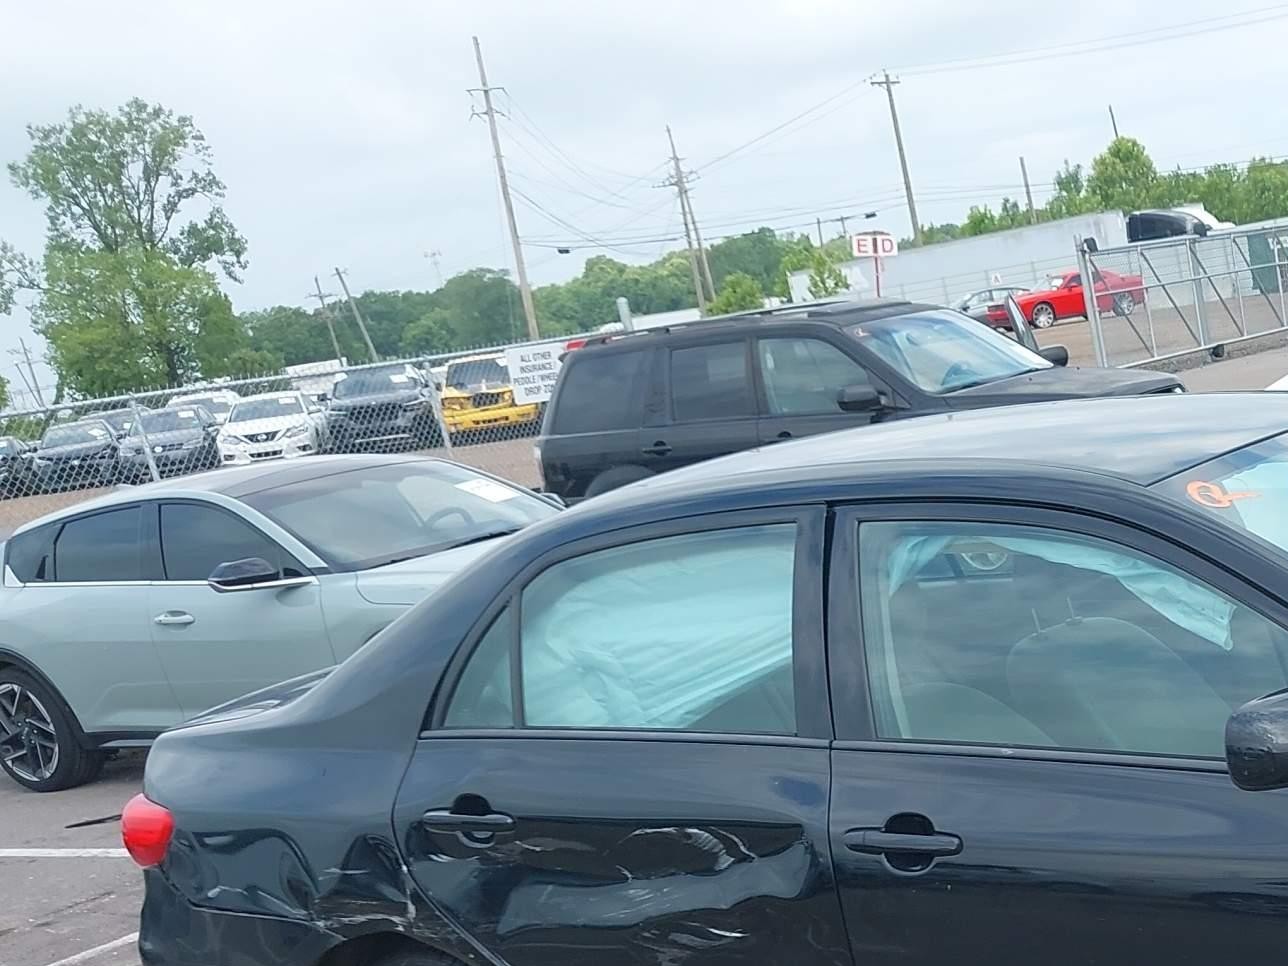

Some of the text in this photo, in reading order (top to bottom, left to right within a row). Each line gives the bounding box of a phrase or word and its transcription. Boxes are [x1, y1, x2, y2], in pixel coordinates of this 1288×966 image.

[520, 351, 551, 363] ALL OTHER
[520, 362, 553, 374] INSURANCE
[524, 386, 541, 396] DROP
